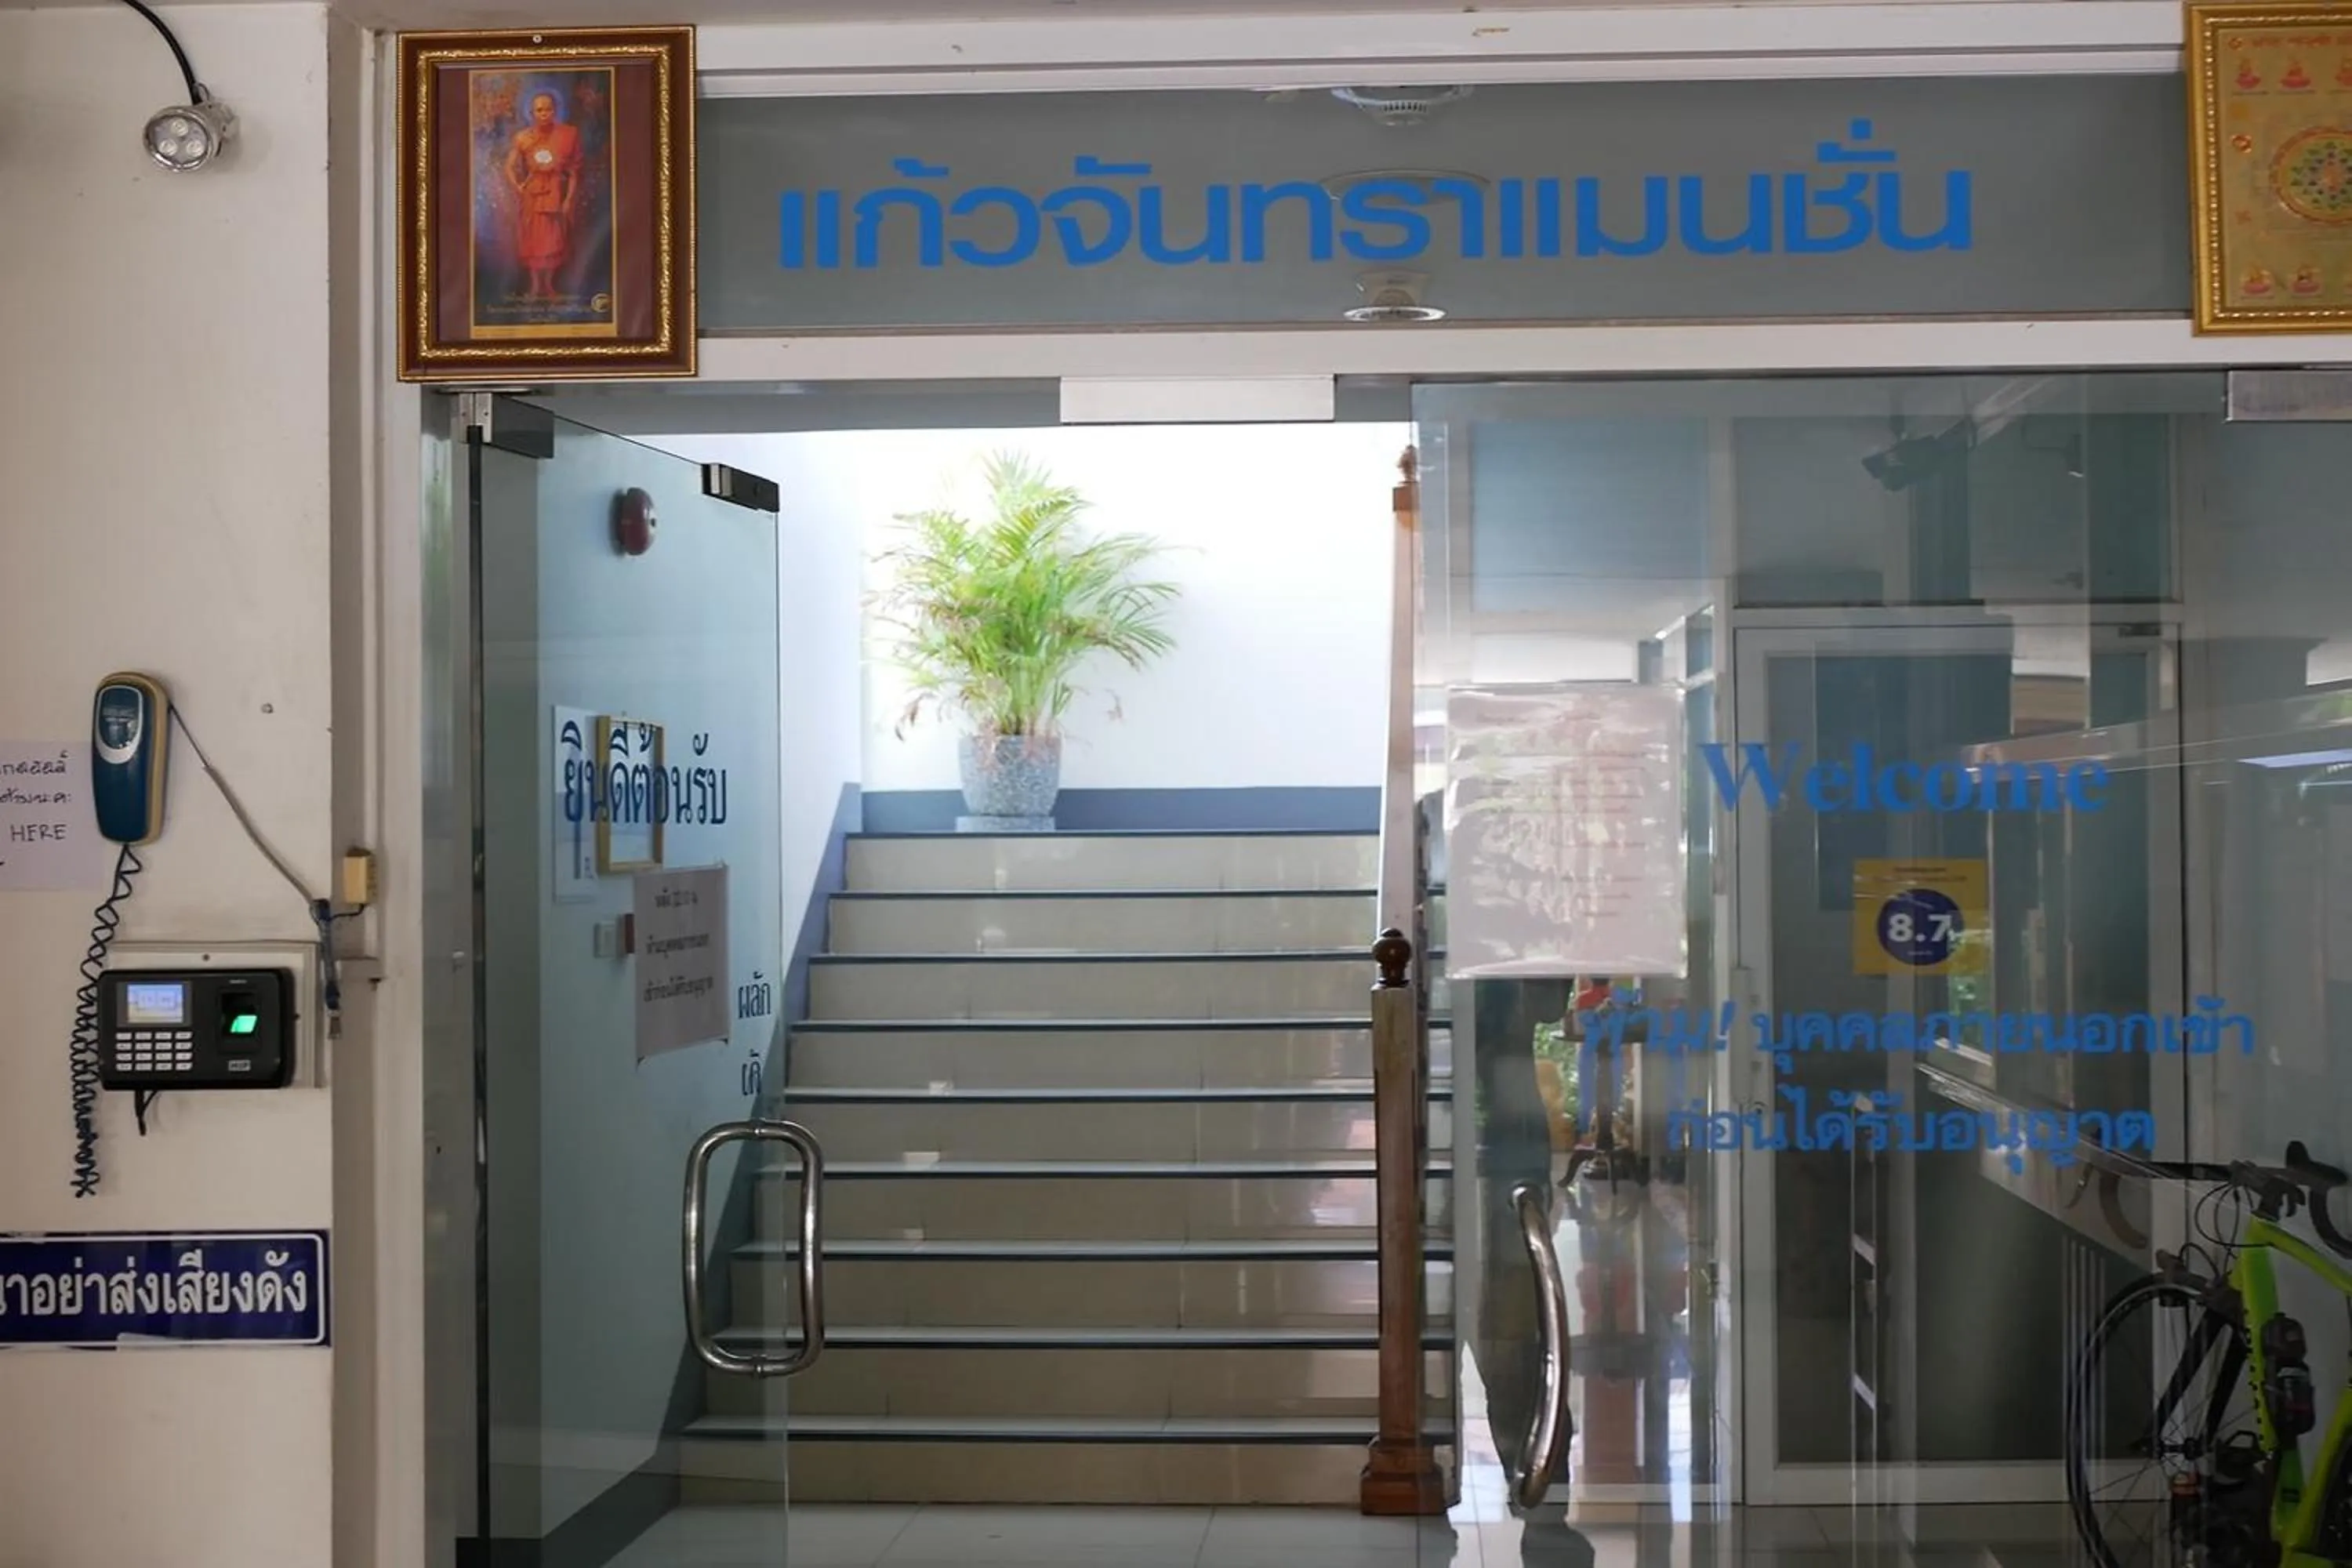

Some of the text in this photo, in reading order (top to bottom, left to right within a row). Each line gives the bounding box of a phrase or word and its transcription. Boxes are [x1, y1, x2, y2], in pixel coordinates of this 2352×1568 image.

[780, 119, 1973, 269] แก้วจันทราแมนชั่น
[561, 719, 727, 826] ยินดีต้อนรับ
[1700, 741, 2111, 813] Welcome
[10, 823, 67, 842] HERE
[1887, 913, 1952, 942] 8.7
[1668, 1084, 2156, 1174] ก่อนได้รับอนุญาต
[0, 1250, 307, 1315] าอย่าส่งเสียงดัง
